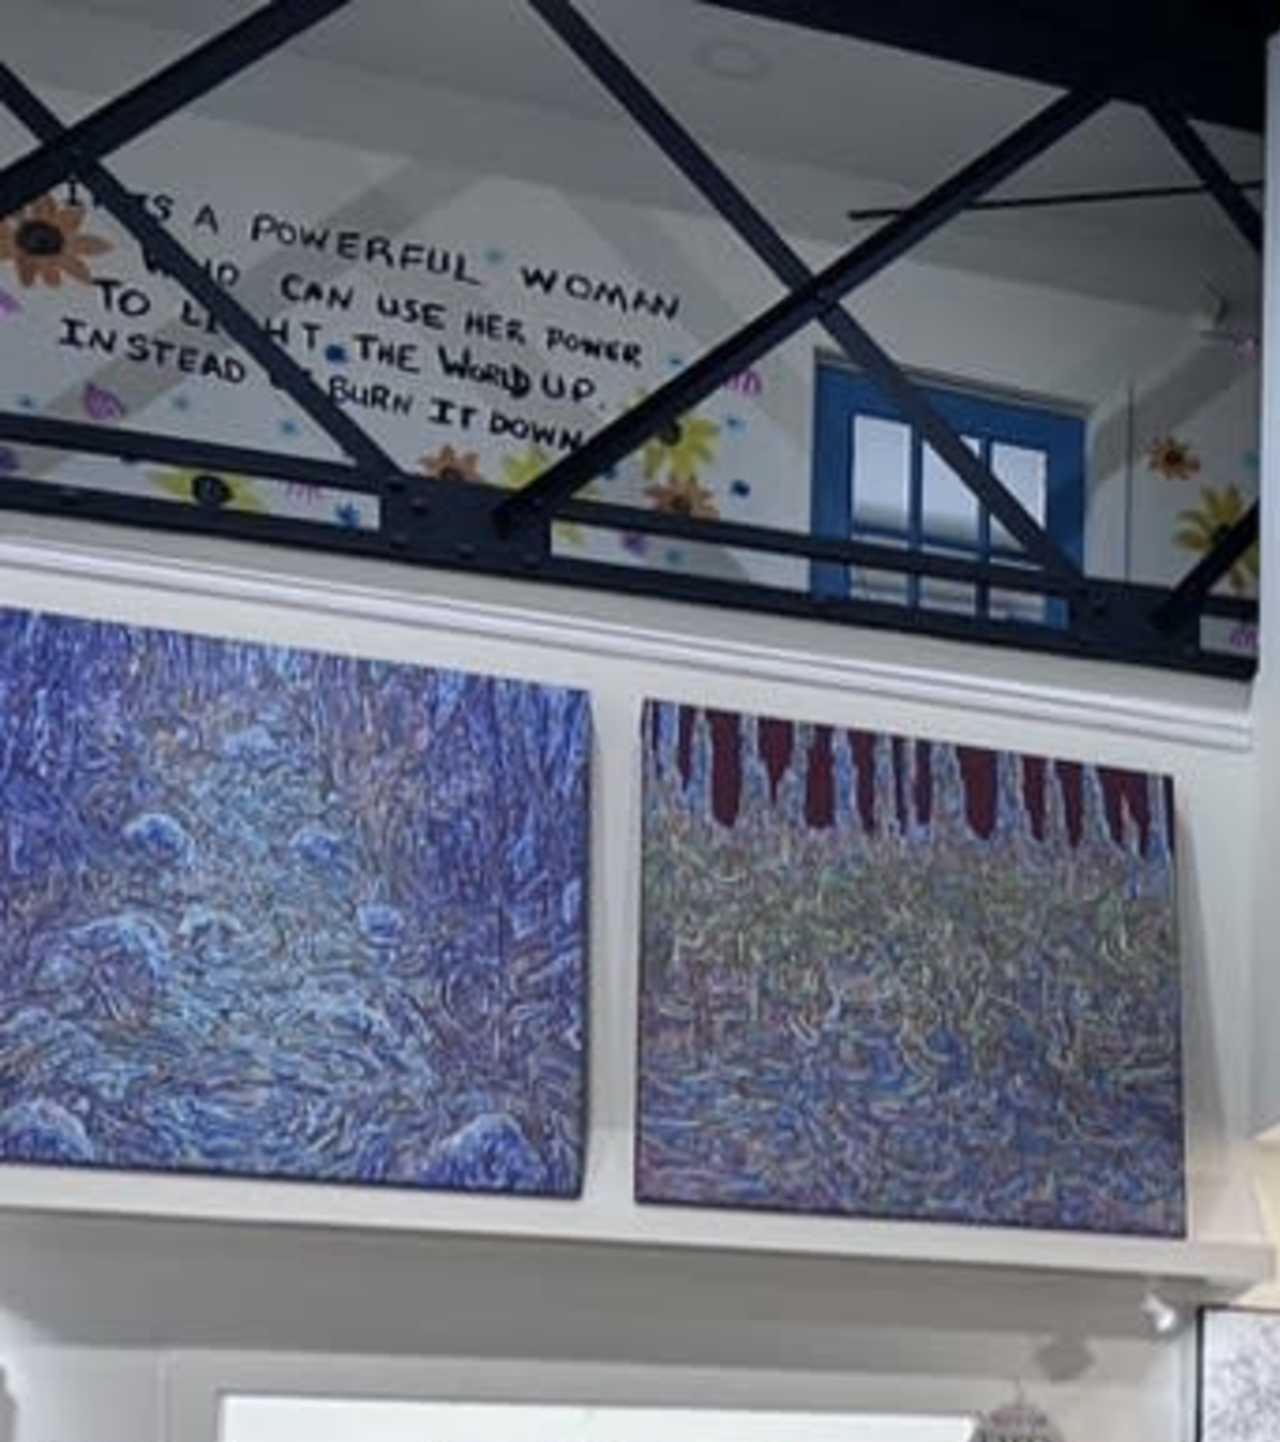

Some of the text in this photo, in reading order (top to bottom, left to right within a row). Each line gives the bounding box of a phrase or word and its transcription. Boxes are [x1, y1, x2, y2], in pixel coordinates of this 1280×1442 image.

[194, 204, 219, 233] A
[251, 212, 482, 286] POWERFUL
[520, 264, 681, 321] WOMAN
[58, 316, 248, 385] INSTEAD
[326, 373, 414, 417] BURN
[426, 397, 478, 431] IT
[92, 279, 151, 317] TO
[180, 300, 323, 351] LIHT
[352, 331, 422, 374] THE
[280, 272, 643, 369] CAN USE HER POWER
